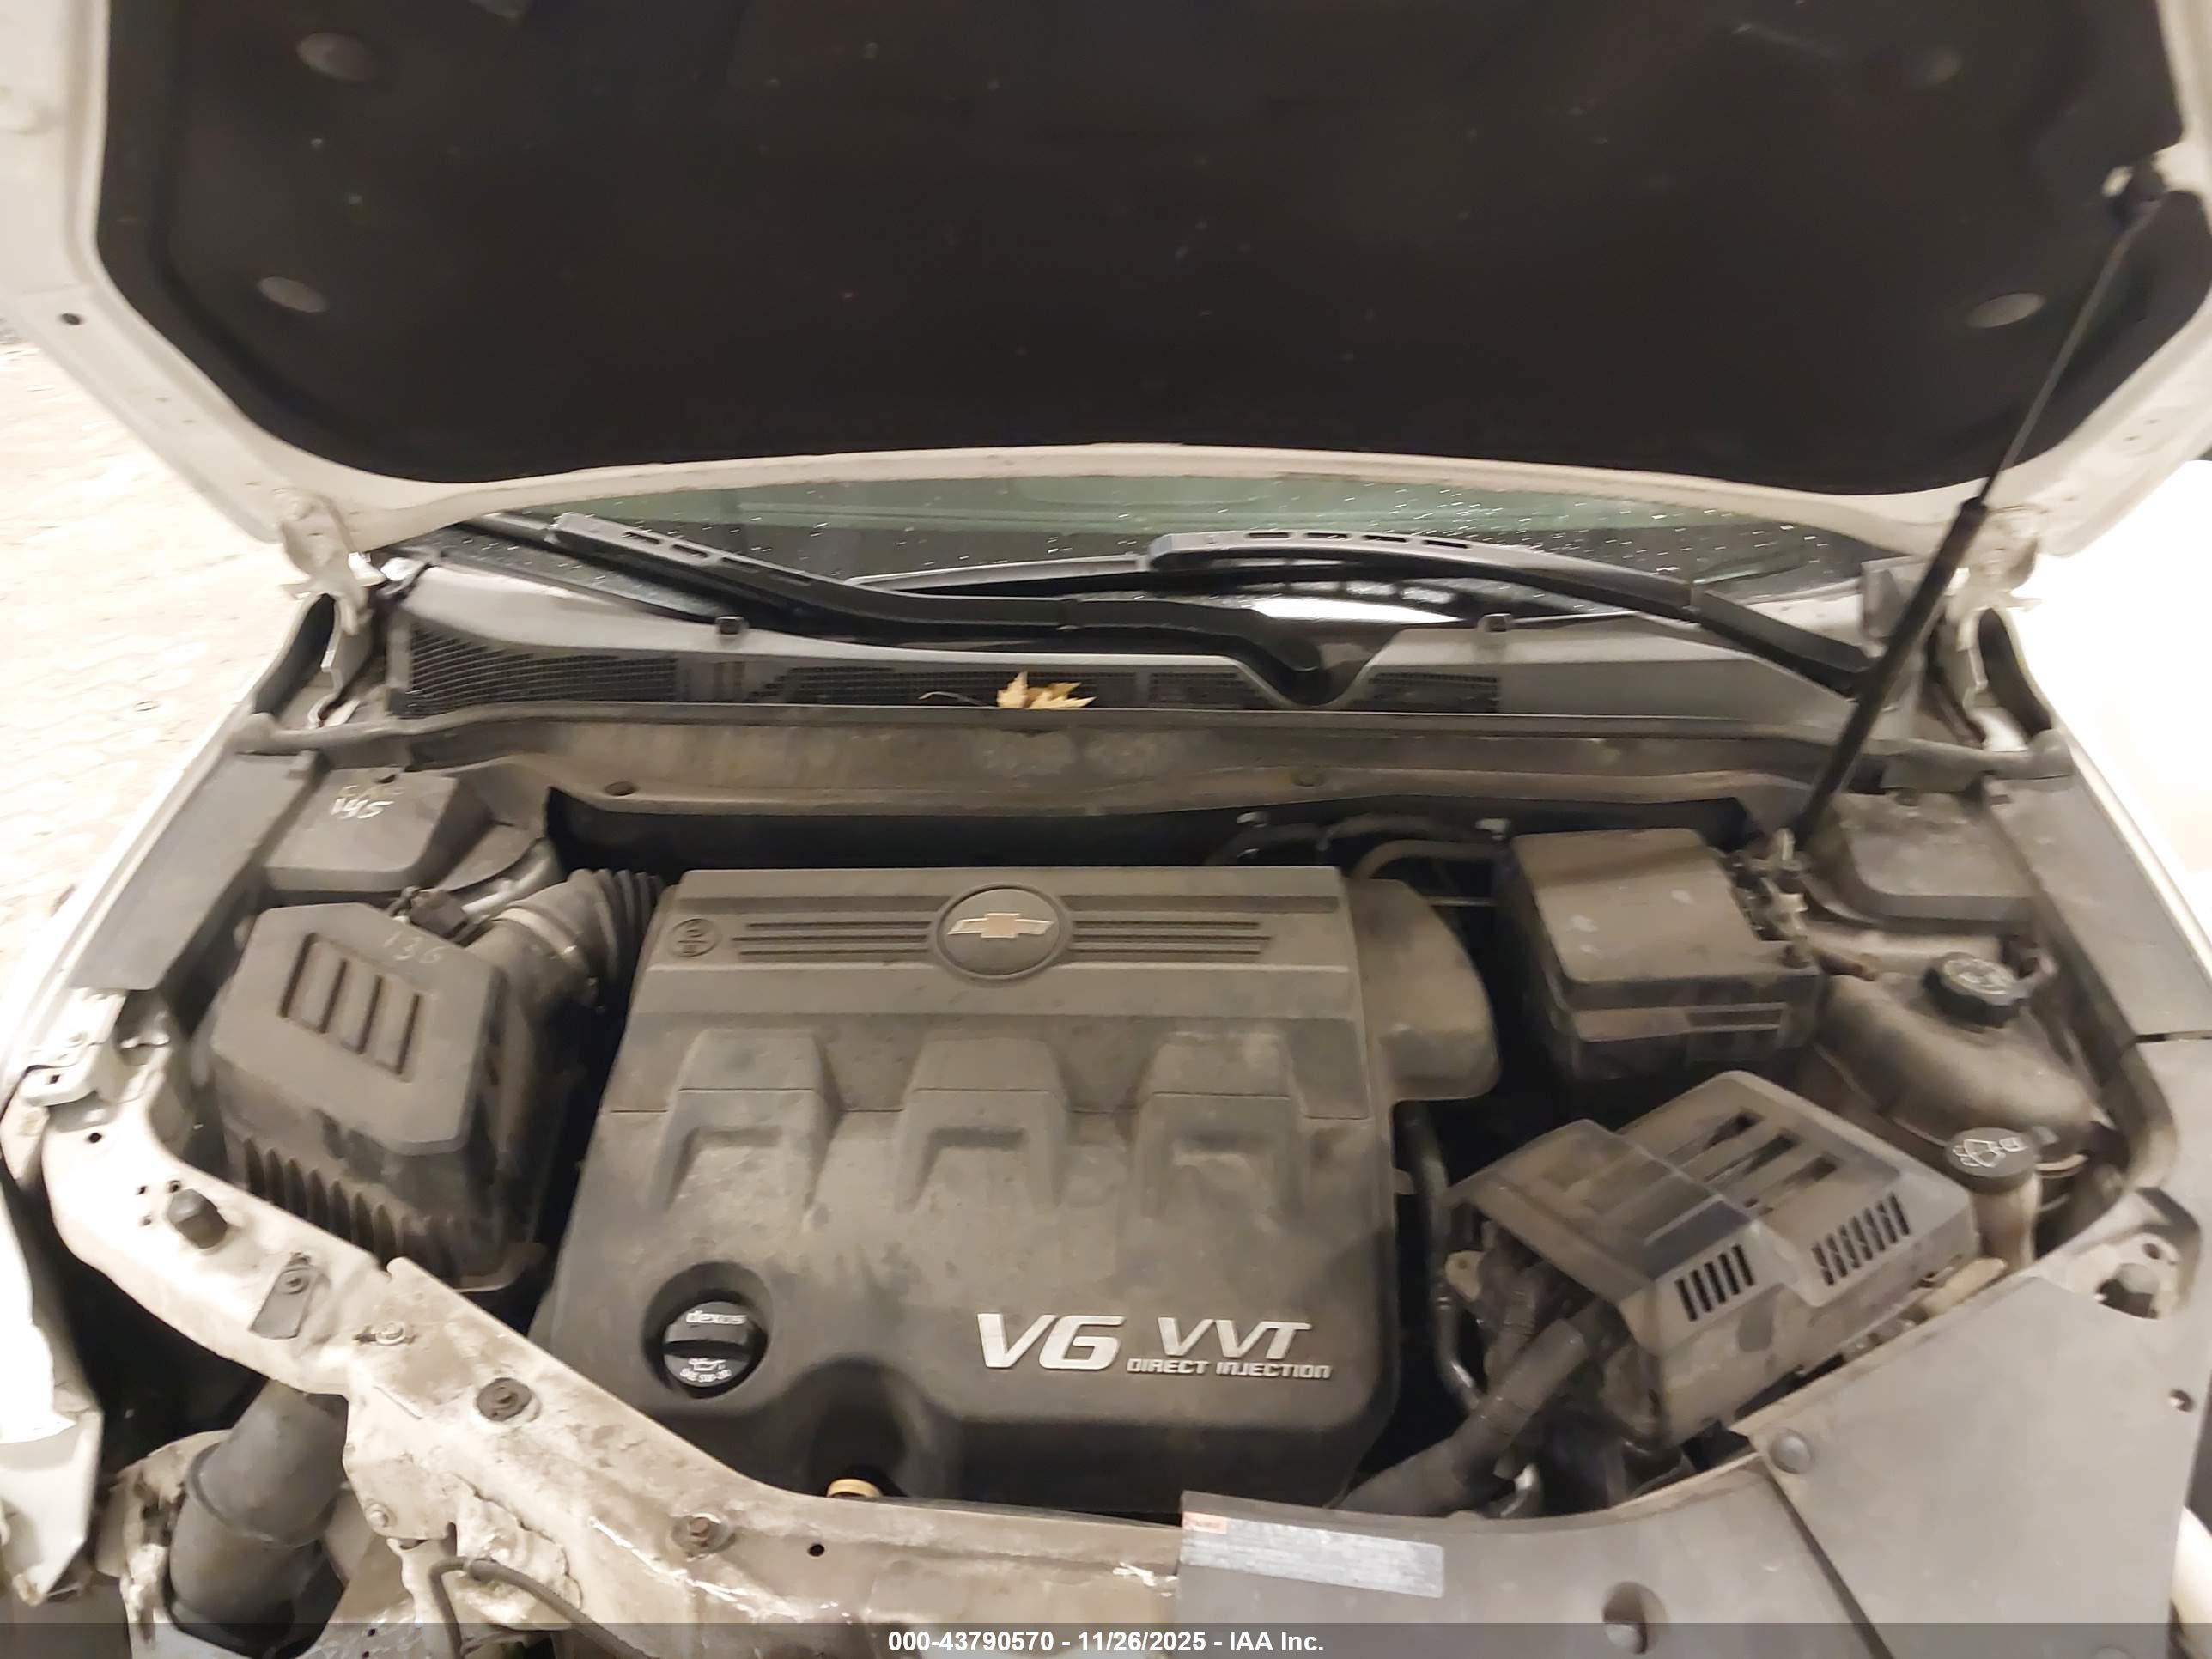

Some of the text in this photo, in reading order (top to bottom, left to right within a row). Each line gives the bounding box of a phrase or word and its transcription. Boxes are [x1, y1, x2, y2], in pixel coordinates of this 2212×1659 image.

[977, 1313, 1312, 1370] V6 VVT
[1127, 1358, 1333, 1379] DIRECT INJECTION
